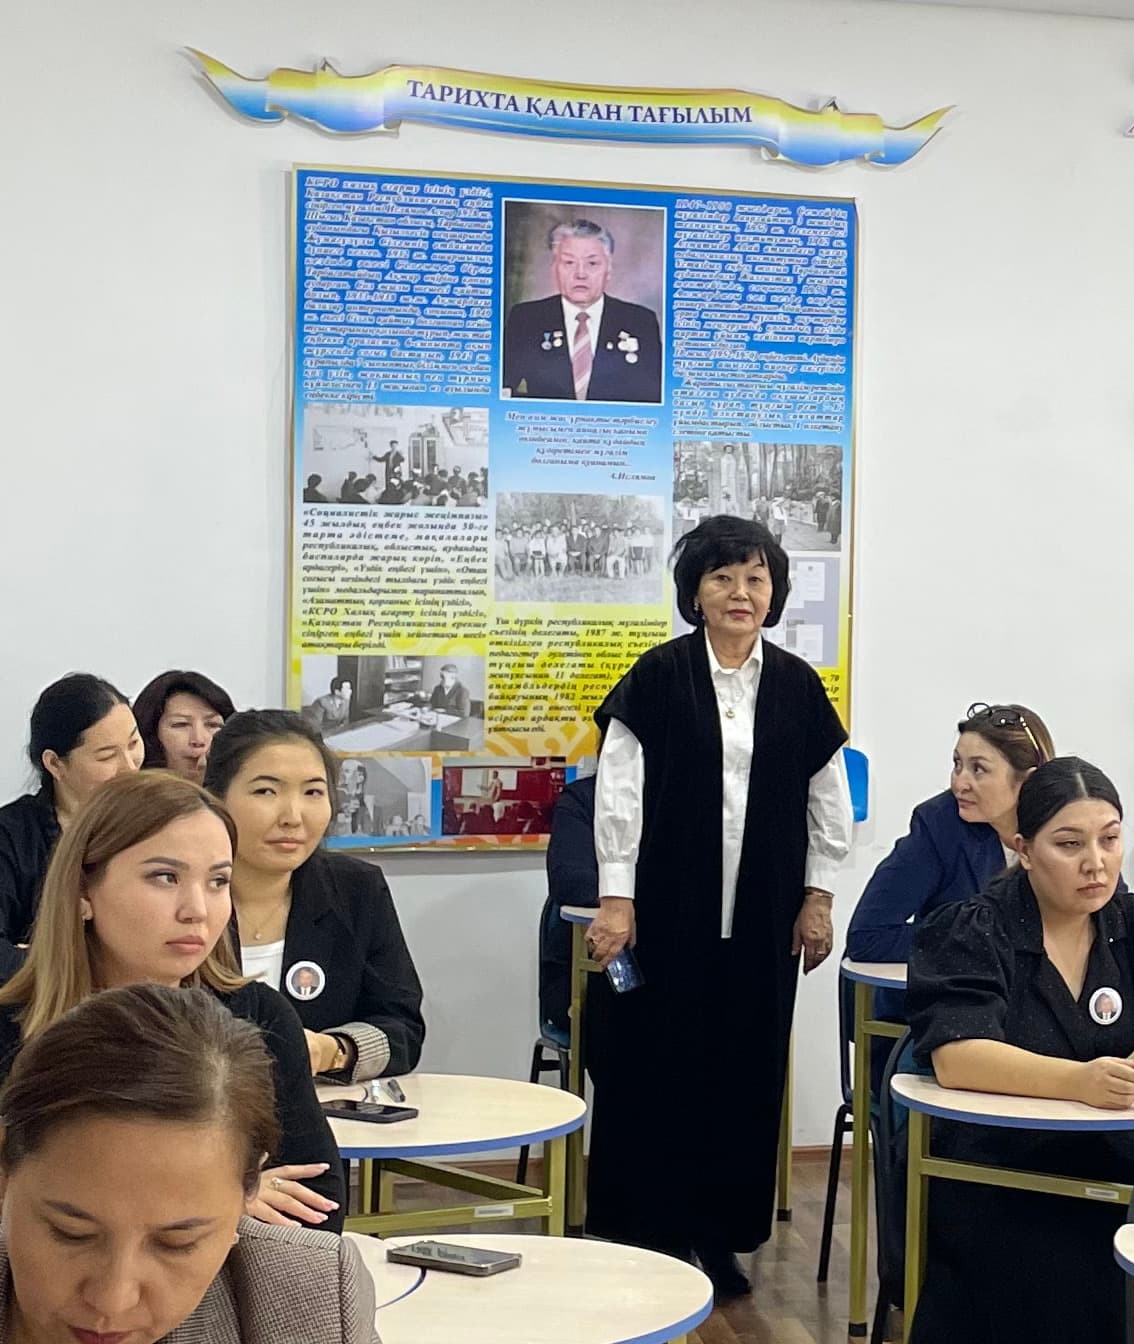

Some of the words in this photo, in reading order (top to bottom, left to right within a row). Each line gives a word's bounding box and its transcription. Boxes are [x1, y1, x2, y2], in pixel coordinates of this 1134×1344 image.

[407, 80, 520, 112] ТАРИХТА
[526, 98, 621, 120] ҚАЛҒАН
[628, 106, 752, 123] ТАҒЫЛЫМ
